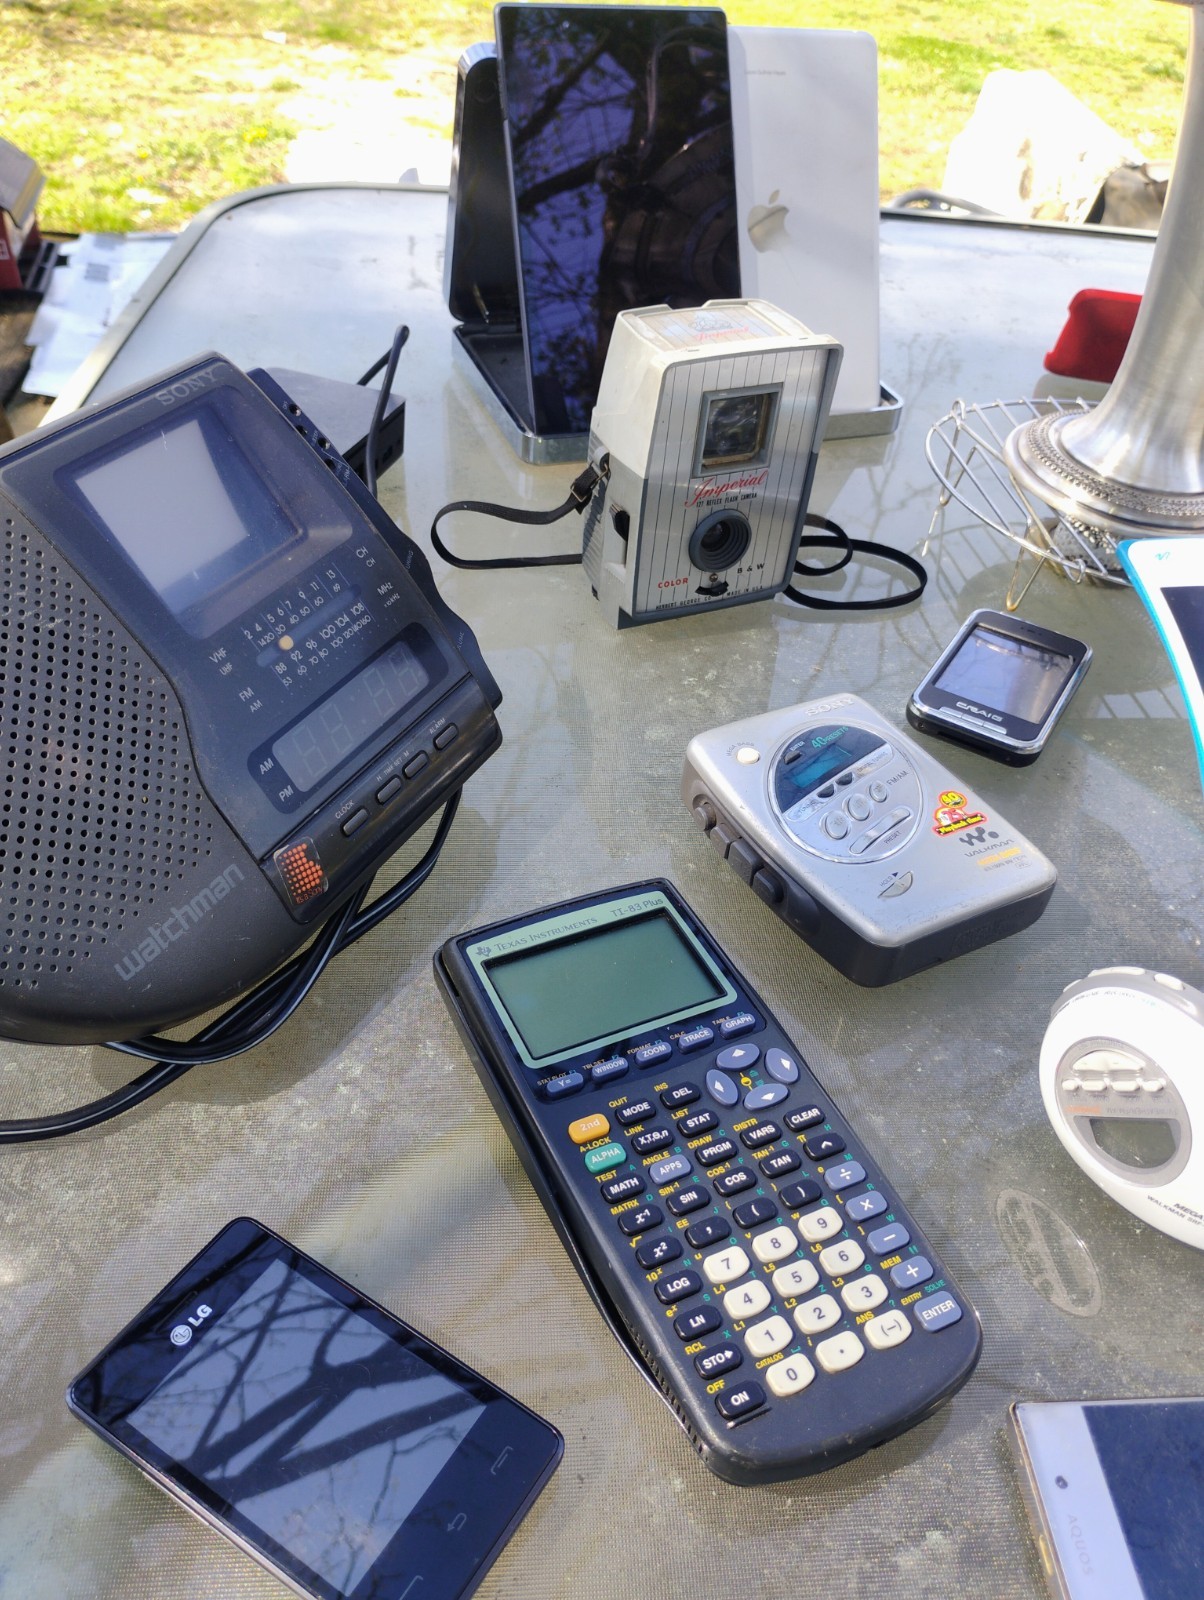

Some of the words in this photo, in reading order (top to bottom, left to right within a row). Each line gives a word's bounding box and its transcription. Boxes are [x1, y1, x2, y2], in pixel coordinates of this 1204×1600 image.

[156, 368, 220, 406] SONY
[684, 470, 769, 508] Imperial
[724, 494, 739, 504] FLASH
[406, 550, 414, 570] UNING
[737, 566, 743, 574] B
[757, 562, 765, 570] W
[658, 577, 689, 589] COLOR
[727, 589, 741, 597] MADE
[209, 647, 228, 664] VHF
[244, 630, 253, 640] 2
[254, 623, 263, 632] 4
[266, 613, 275, 623] 5
[277, 607, 285, 616] 6
[285, 600, 293, 610] 7
[298, 591, 306, 600] 9
[310, 581, 319, 592] 11
[326, 569, 336, 580] 13
[356, 546, 369, 558] CH
[219, 662, 234, 676] UHF
[265, 632, 275, 643] 20
[276, 624, 286, 635] 30
[289, 614, 300, 625] 40
[300, 606, 311, 617] 50
[314, 596, 324, 607] 60
[366, 558, 377, 568] CH
[239, 687, 255, 702] FM
[275, 662, 288, 675] 88
[290, 650, 304, 663] 92
[306, 639, 318, 650] 96
[319, 625, 336, 640] 100
[335, 613, 350, 628] 104
[350, 602, 365, 616] 108
[377, 582, 394, 596] MHz
[250, 699, 263, 713] AM
[283, 676, 293, 687] 53
[297, 665, 307, 676] 60
[309, 656, 319, 665] 70
[318, 647, 329, 658] 80
[330, 636, 344, 649] 100
[342, 628, 354, 640] 120
[805, 699, 853, 717] SONY
[956, 701, 1004, 722] CRAIG
[429, 717, 446, 735] ALARM
[259, 758, 274, 775] AM
[278, 785, 294, 802] PM
[335, 800, 354, 820] CLOCK
[884, 830, 902, 844] PRESET
[880, 875, 893, 887] HOLD
[114, 863, 245, 981] watchman
[494, 932, 528, 952] TEXAS
[528, 917, 598, 942] INSTRUMENTS
[610, 902, 643, 918] TI-83
[642, 898, 664, 910] Plus
[712, 1015, 731, 1025] TABLE
[725, 1016, 753, 1030] GRAPH
[669, 1031, 686, 1041] CALC
[683, 1030, 711, 1044] TRACE
[627, 1042, 652, 1055] FORMAT
[643, 1044, 667, 1058] ZOOM
[594, 1059, 625, 1074] WINDOW
[654, 1082, 669, 1092] INS
[672, 1086, 693, 1099] DEL
[608, 1096, 628, 1108] QUIT
[622, 1101, 651, 1117] MODE
[671, 1108, 689, 1120] LIST
[686, 1113, 711, 1128] STAT
[791, 1107, 821, 1124] CLEAR
[580, 1119, 600, 1132] 2nd
[623, 1125, 645, 1137] LINK
[733, 1118, 758, 1132] DISTR
[749, 1124, 776, 1140] VARS
[579, 1136, 612, 1153] A-LOCK
[687, 1135, 713, 1149] DRAW
[591, 1147, 621, 1164] ALPHA
[702, 1141, 732, 1158] PRGM
[642, 1151, 671, 1166] ANGLE
[770, 1154, 792, 1168] TAN
[660, 1161, 682, 1176] APPS
[594, 1170, 618, 1183] TEST
[725, 1172, 747, 1186] COS
[609, 1177, 639, 1195] MATH
[679, 1191, 698, 1204] SIN
[610, 1199, 639, 1216] MATRX
[1147, 1195, 1186, 1218] WALKMAN
[1173, 1203, 1203, 1220] MEGA
[675, 1218, 690, 1229] EE
[816, 1217, 828, 1229] 9
[770, 1237, 782, 1249] 8
[810, 1243, 823, 1254] L6
[838, 1250, 849, 1262] 6
[880, 1255, 902, 1270] MEM
[721, 1257, 731, 1270] 7
[763, 1262, 776, 1274] L5
[790, 1271, 803, 1283] 5
[832, 1277, 845, 1288] L3
[666, 1277, 691, 1293] LOG
[713, 1284, 726, 1295] L4
[861, 1286, 873, 1298] 3
[743, 1292, 753, 1305] 4
[900, 1291, 923, 1306] ENTRY
[924, 1279, 946, 1293] SOLVE
[784, 1298, 797, 1309] L2
[922, 1299, 955, 1321] ENTER
[187, 1304, 213, 1327] LG
[813, 1307, 826, 1320] 2
[855, 1311, 875, 1325] ANS
[689, 1314, 706, 1328] LN
[733, 1320, 746, 1331] L1
[764, 1329, 775, 1341] 1
[684, 1341, 706, 1355] RCL
[755, 1352, 784, 1369] CATALOG
[786, 1368, 798, 1381] 0
[706, 1379, 726, 1394] OFF
[730, 1390, 750, 1406] ON
[1067, 1514, 1095, 1576] AQUOS
